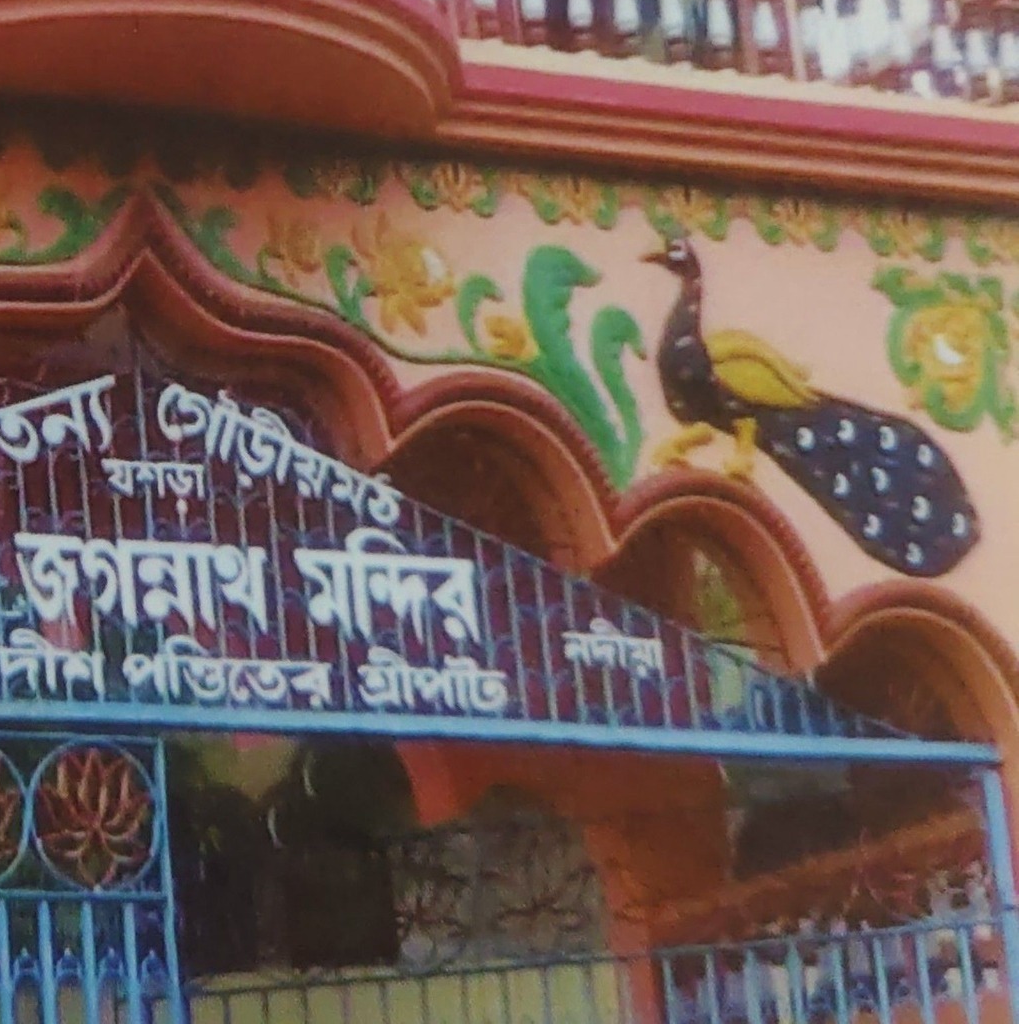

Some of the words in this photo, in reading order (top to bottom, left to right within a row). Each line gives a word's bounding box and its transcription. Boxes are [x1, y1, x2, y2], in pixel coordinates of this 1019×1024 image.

[14, 533, 268, 632] জগন্নাথ
[293, 527, 480, 645] মন্দির
[561, 617, 666, 682] নদীয়া
